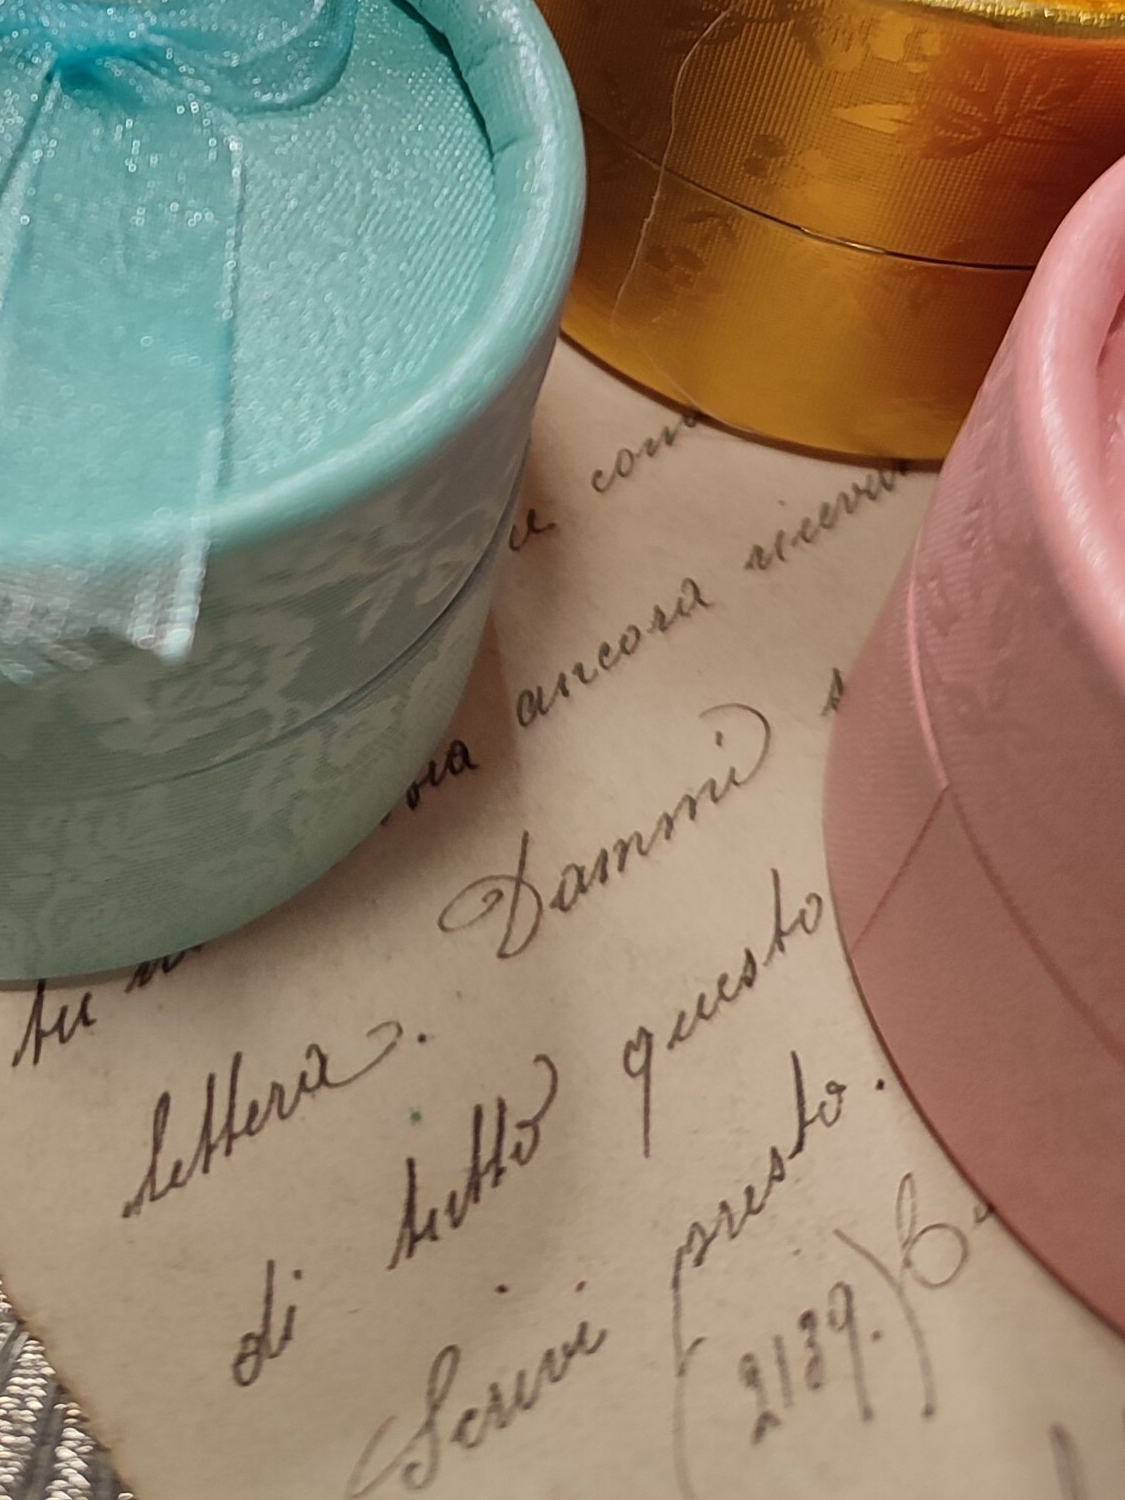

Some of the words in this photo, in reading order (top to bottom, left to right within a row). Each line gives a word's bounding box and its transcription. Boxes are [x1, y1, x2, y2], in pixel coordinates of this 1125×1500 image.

[516, 577, 714, 729] ancora
[437, 702, 771, 959] Dammi
[231, 1258, 303, 1387] di
[386, 1053, 559, 1271] tutto
[622, 867, 823, 1159] questo
